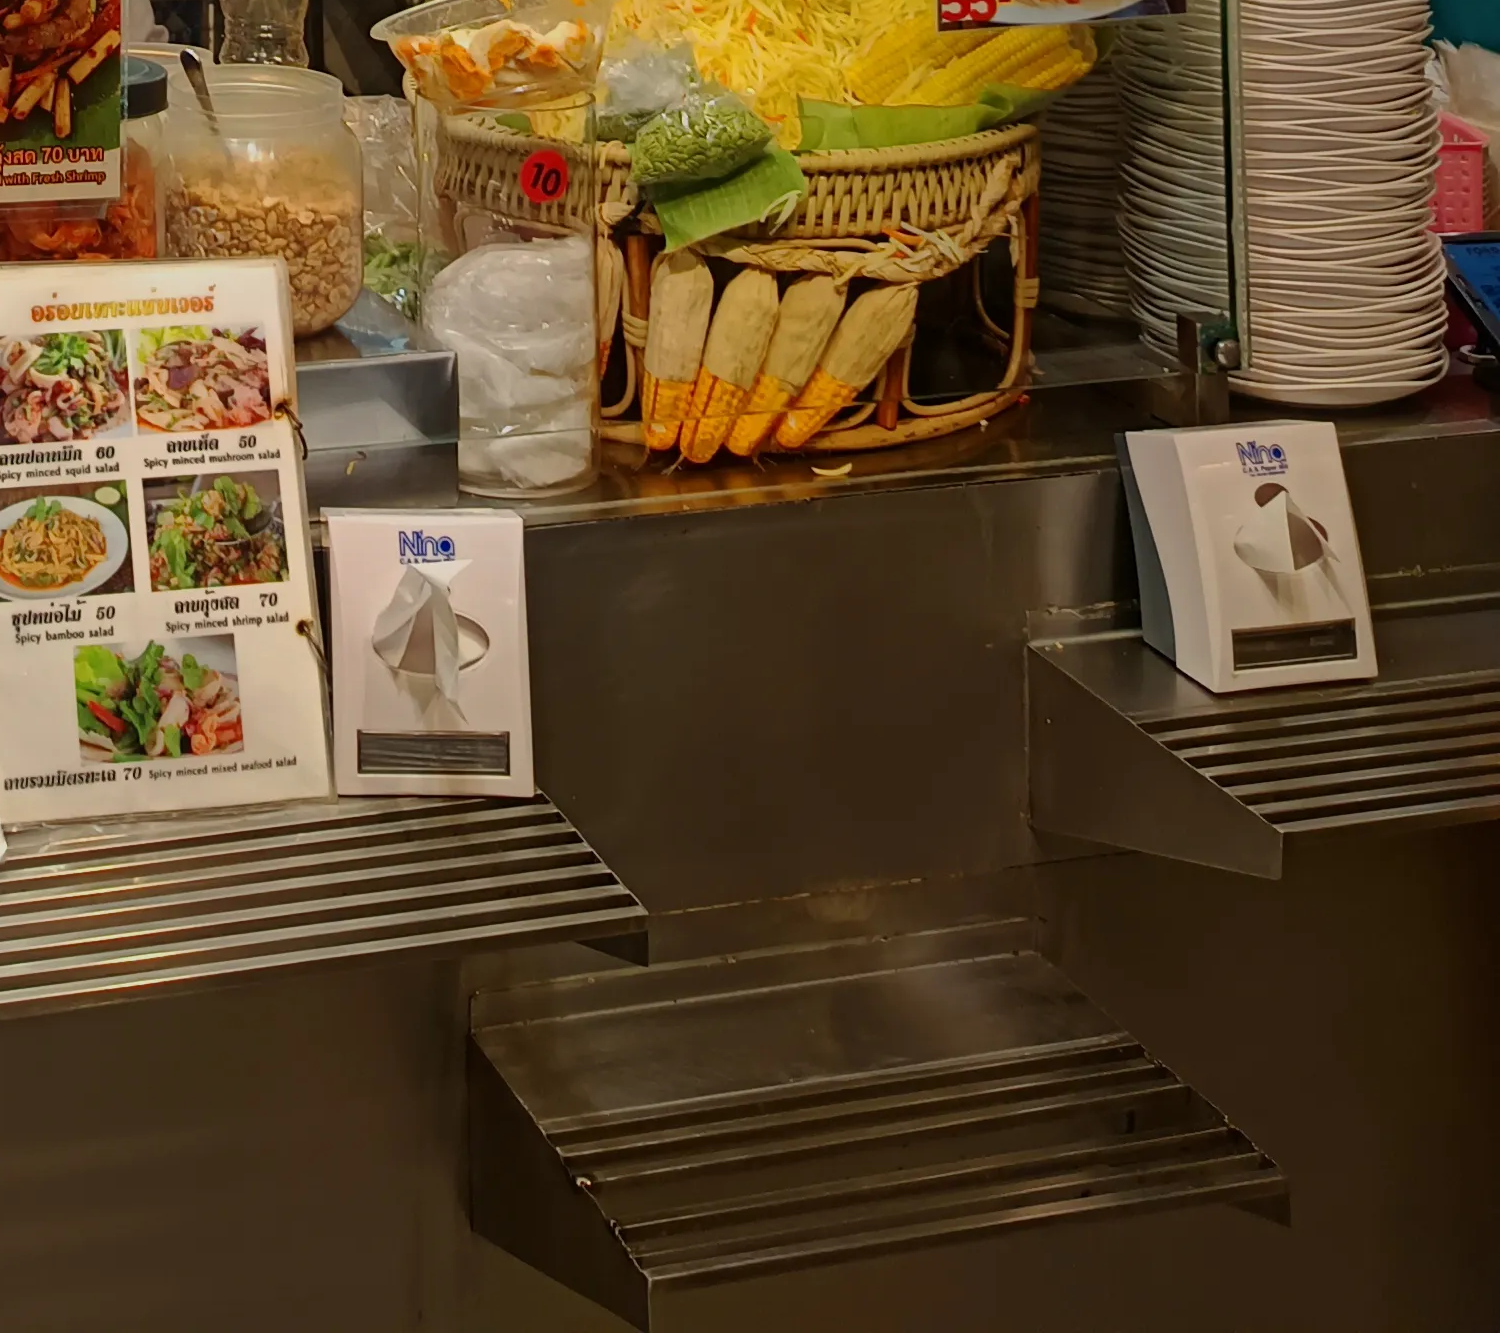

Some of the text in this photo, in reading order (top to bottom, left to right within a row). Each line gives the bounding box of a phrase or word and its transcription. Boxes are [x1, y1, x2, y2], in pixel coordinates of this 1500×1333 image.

[41, 147, 63, 164] 70
[67, 147, 105, 163] บาท
[4, 172, 30, 185] with
[31, 171, 63, 185] Fresh
[65, 169, 106, 185] Shrimp
[530, 162, 561, 197] 10
[238, 435, 257, 450] 50
[95, 446, 115, 460] 60
[143, 449, 280, 469] Spicy minced mushroom salad
[26, 467, 61, 479] minced
[65, 464, 91, 479] squid
[95, 462, 120, 476] salad
[259, 593, 279, 608] 70
[95, 606, 116, 621] 50
[165, 612, 290, 633] Spicy minced shrimp salad
[15, 626, 114, 645] Spicy bamboo salad
[122, 767, 142, 782] 70
[149, 768, 172, 781] Spicy
[175, 766, 208, 777] minced
[211, 763, 238, 775] mixed
[240, 760, 273, 772] seafood
[275, 757, 297, 768] salad
